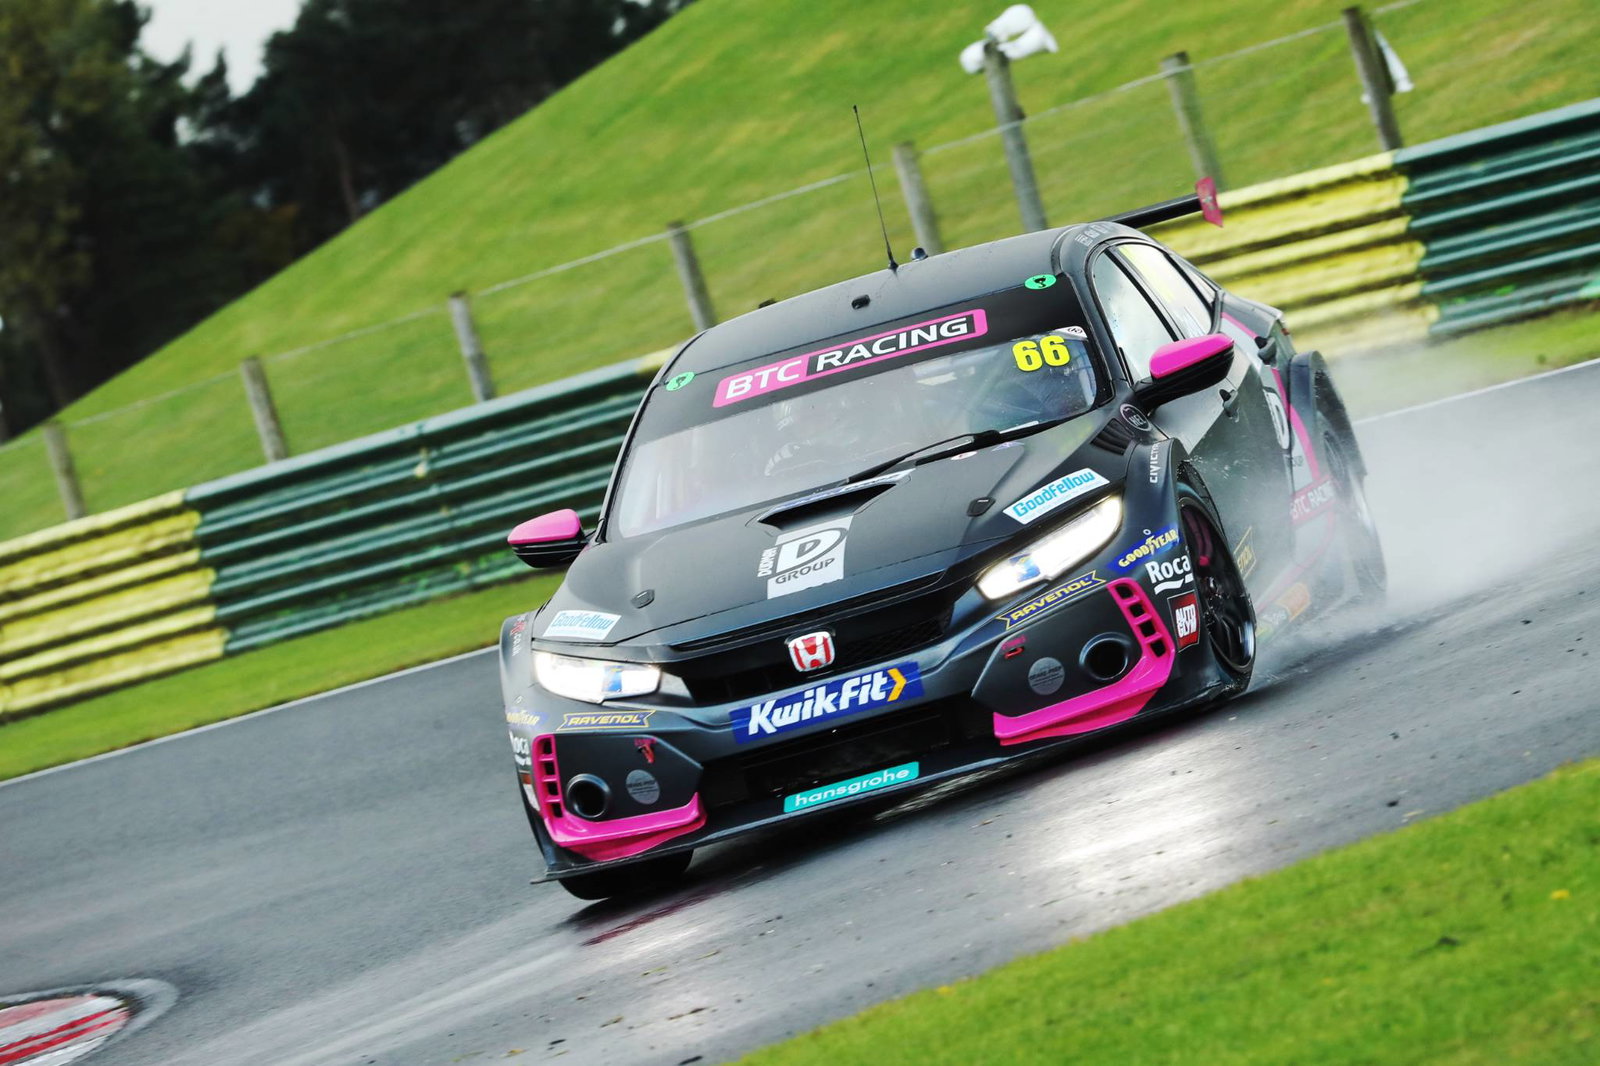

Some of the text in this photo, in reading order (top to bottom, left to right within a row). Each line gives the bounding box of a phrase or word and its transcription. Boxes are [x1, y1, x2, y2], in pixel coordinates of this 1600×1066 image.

[725, 317, 967, 399] BTC RACING
[1012, 335, 1070, 372] 66
[775, 557, 835, 585] GROUP
[1145, 555, 1191, 584] Roca
[1010, 579, 1093, 621] RAVENOL
[567, 714, 640, 726] RAVENOL
[794, 770, 910, 806] hansgrohe
